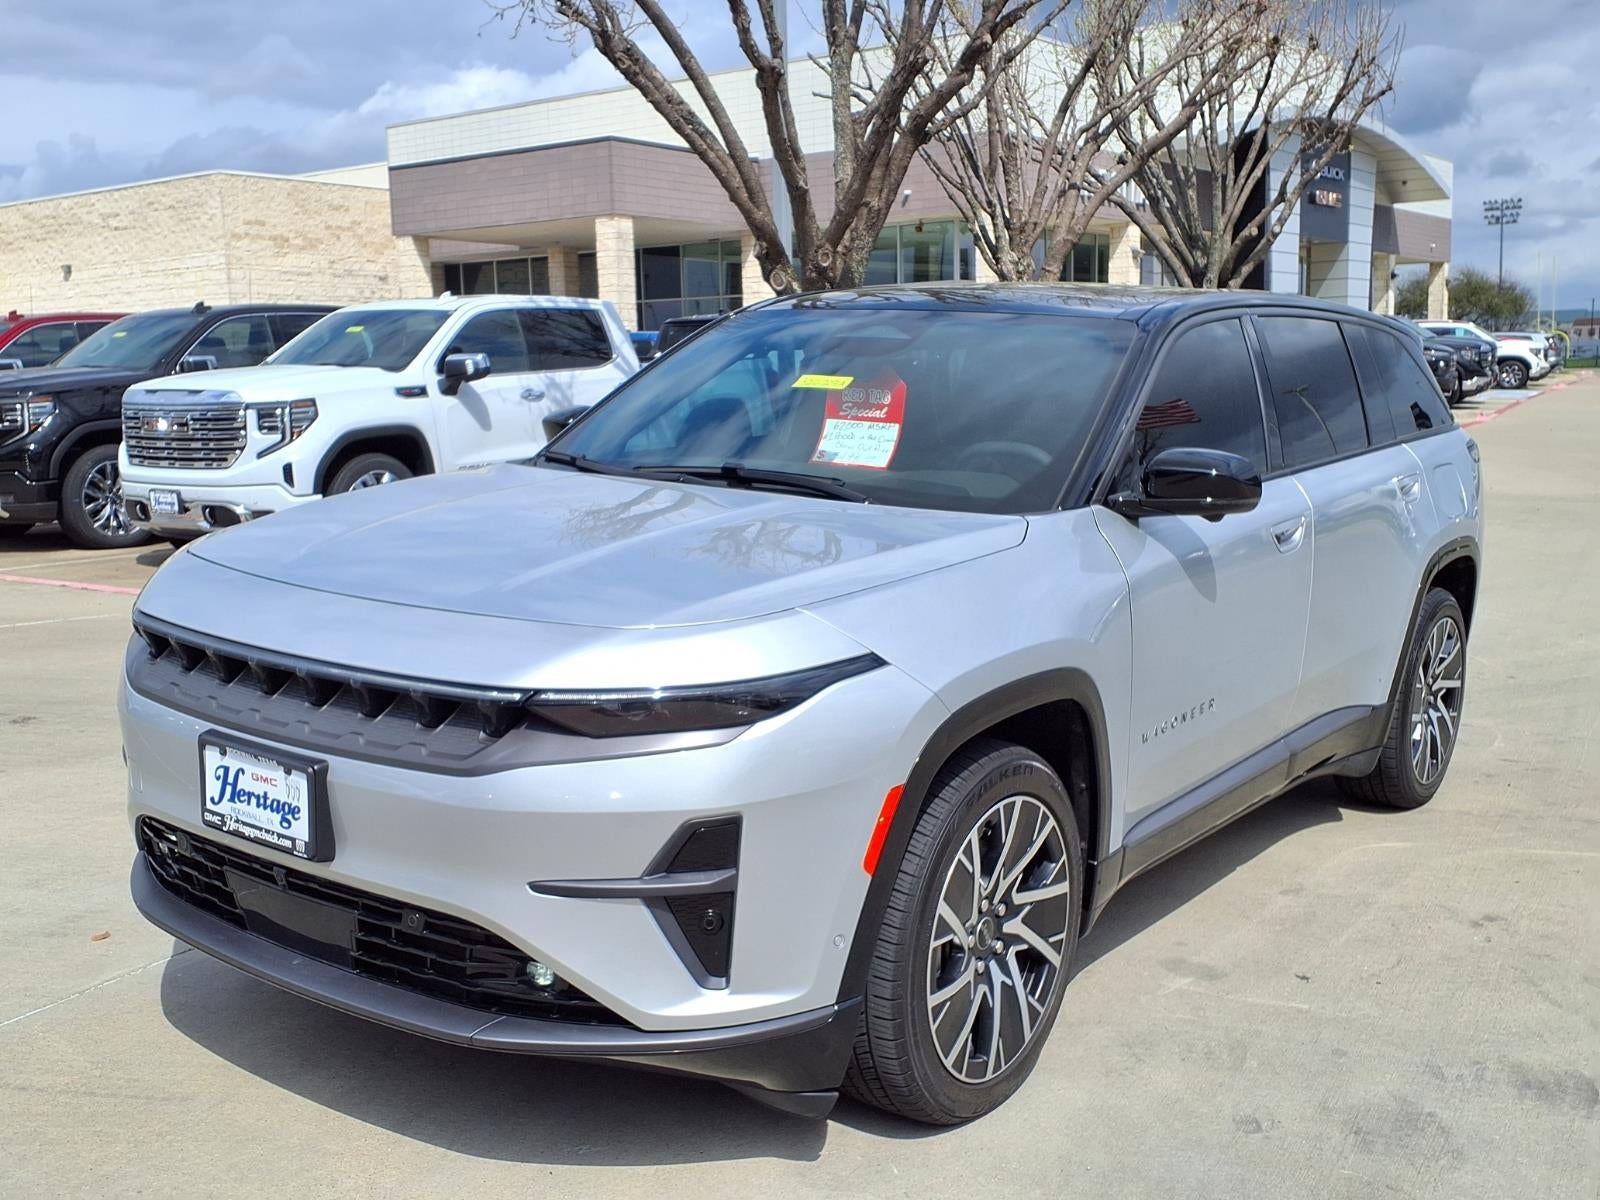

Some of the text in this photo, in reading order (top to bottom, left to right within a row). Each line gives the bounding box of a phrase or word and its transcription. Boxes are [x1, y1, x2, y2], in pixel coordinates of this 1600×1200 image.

[868, 388, 892, 405] TAG
[839, 402, 887, 419] Special
[1141, 697, 1215, 744] WAGONEER
[251, 771, 278, 788] GMC
[209, 764, 301, 830] Heritage
[204, 811, 222, 825] GMC
